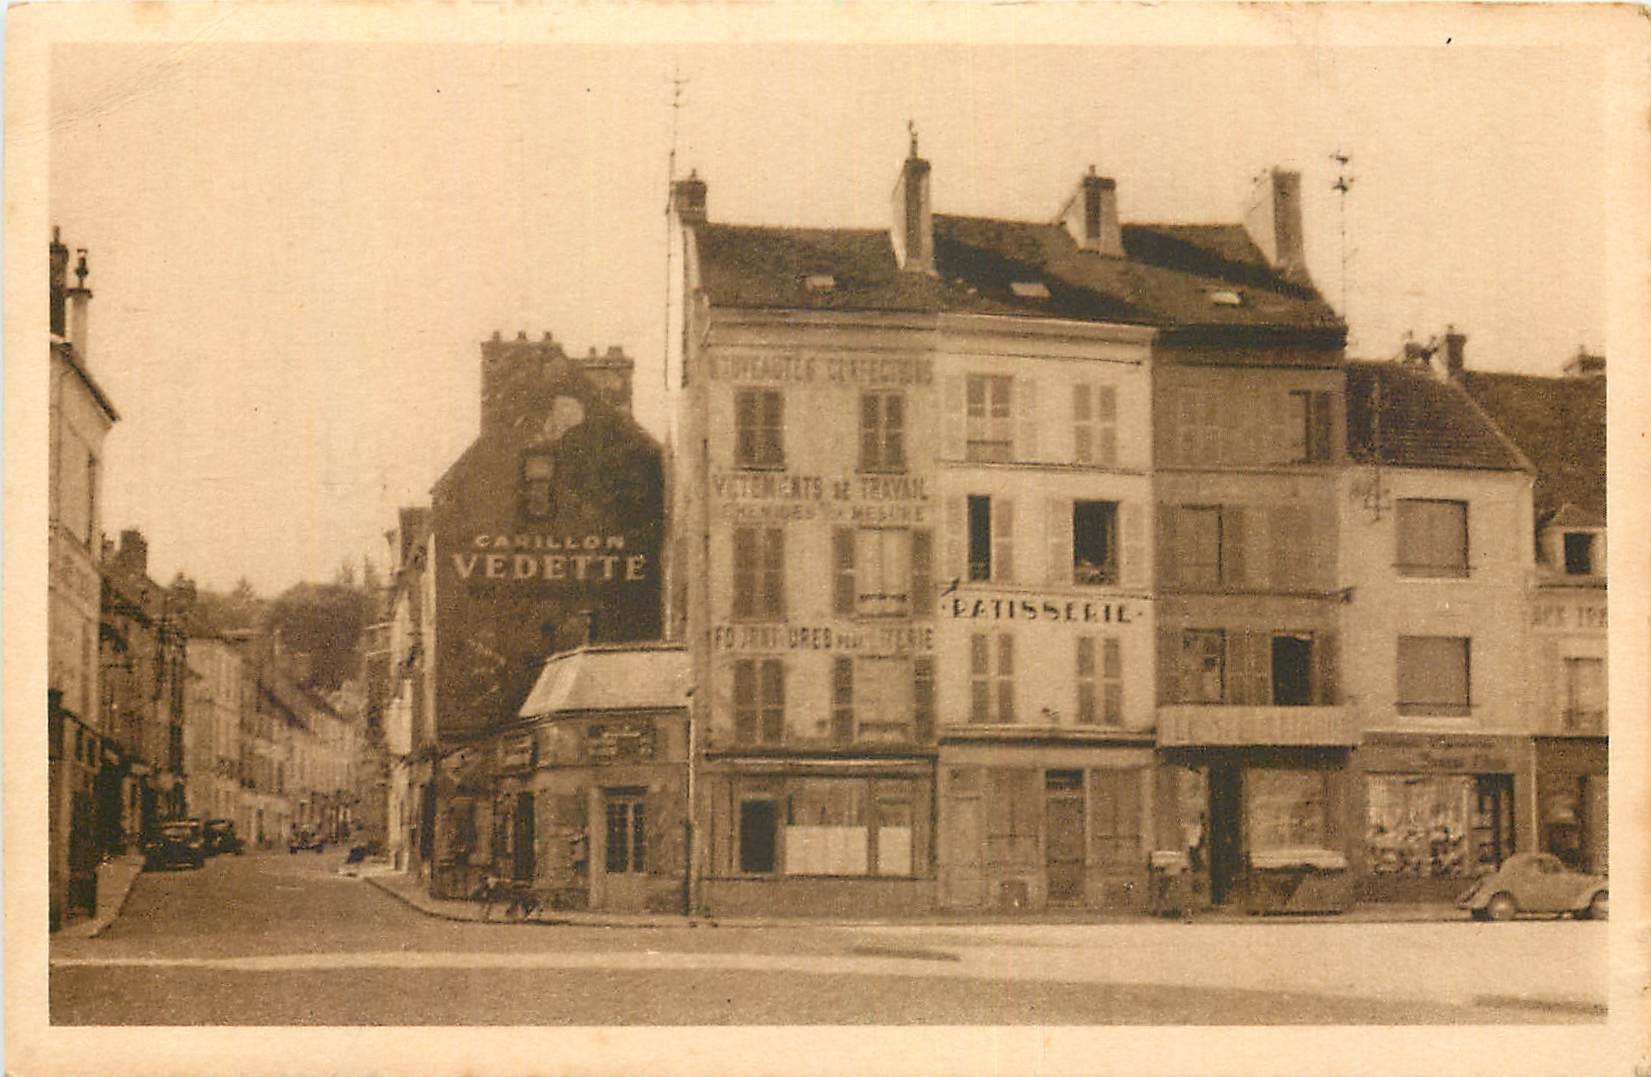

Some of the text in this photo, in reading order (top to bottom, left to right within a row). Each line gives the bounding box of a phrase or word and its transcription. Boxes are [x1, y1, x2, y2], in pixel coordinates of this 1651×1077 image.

[475, 535, 625, 549] CARILLON
[452, 553, 647, 581] VEDETTE
[953, 598, 1132, 624] PATISSERIE
